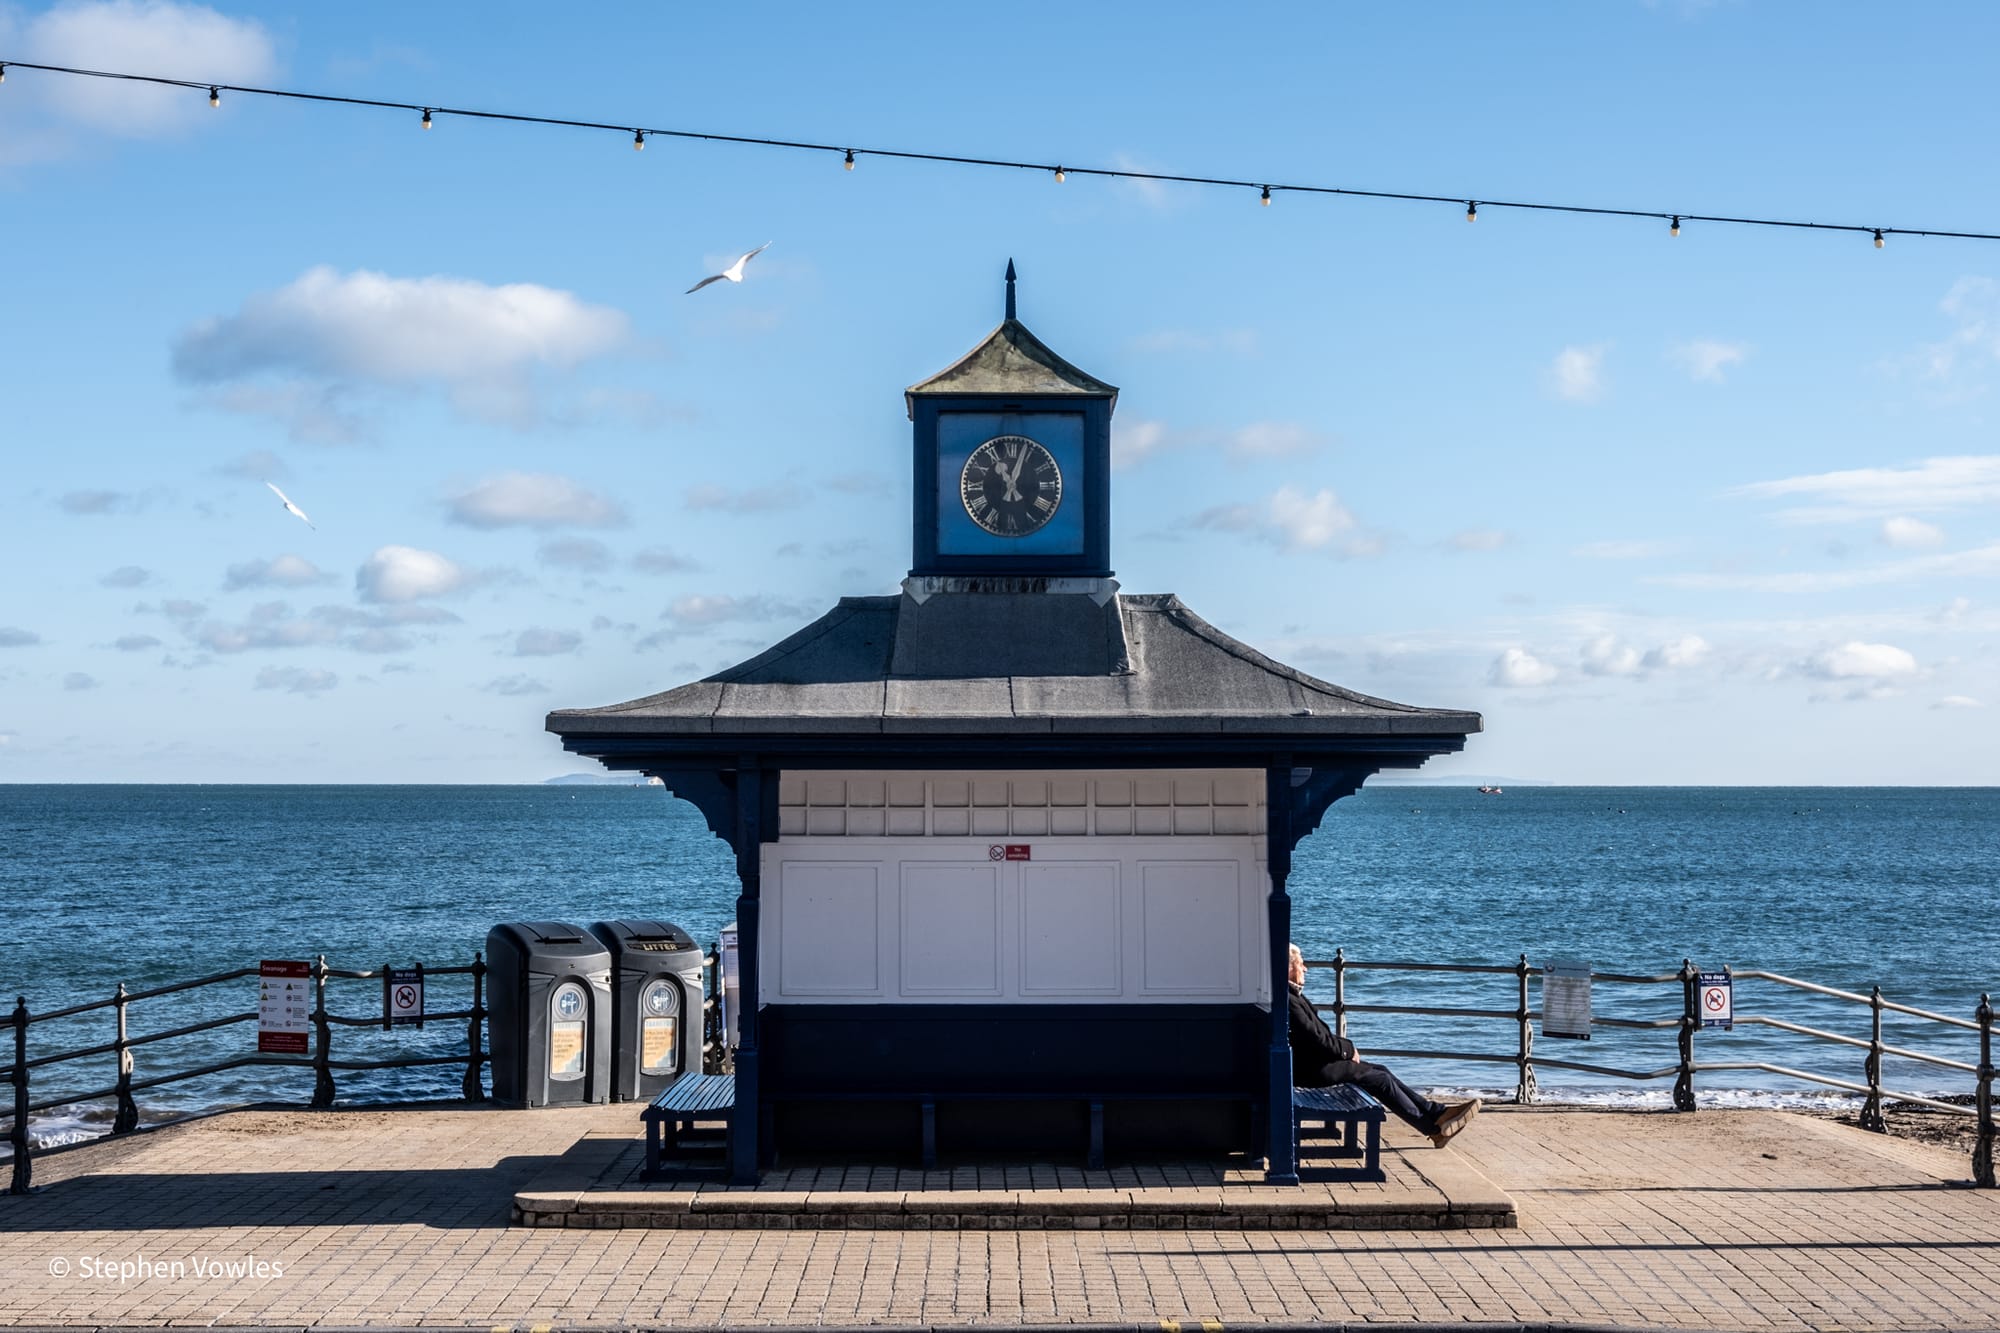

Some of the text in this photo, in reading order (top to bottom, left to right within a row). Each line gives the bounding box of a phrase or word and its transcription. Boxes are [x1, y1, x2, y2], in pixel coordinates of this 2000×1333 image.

[984, 446, 1001, 464] XI
[1004, 442, 1017, 458] XII
[642, 943, 678, 951] LITTER
[262, 964, 288, 974] Swanage
